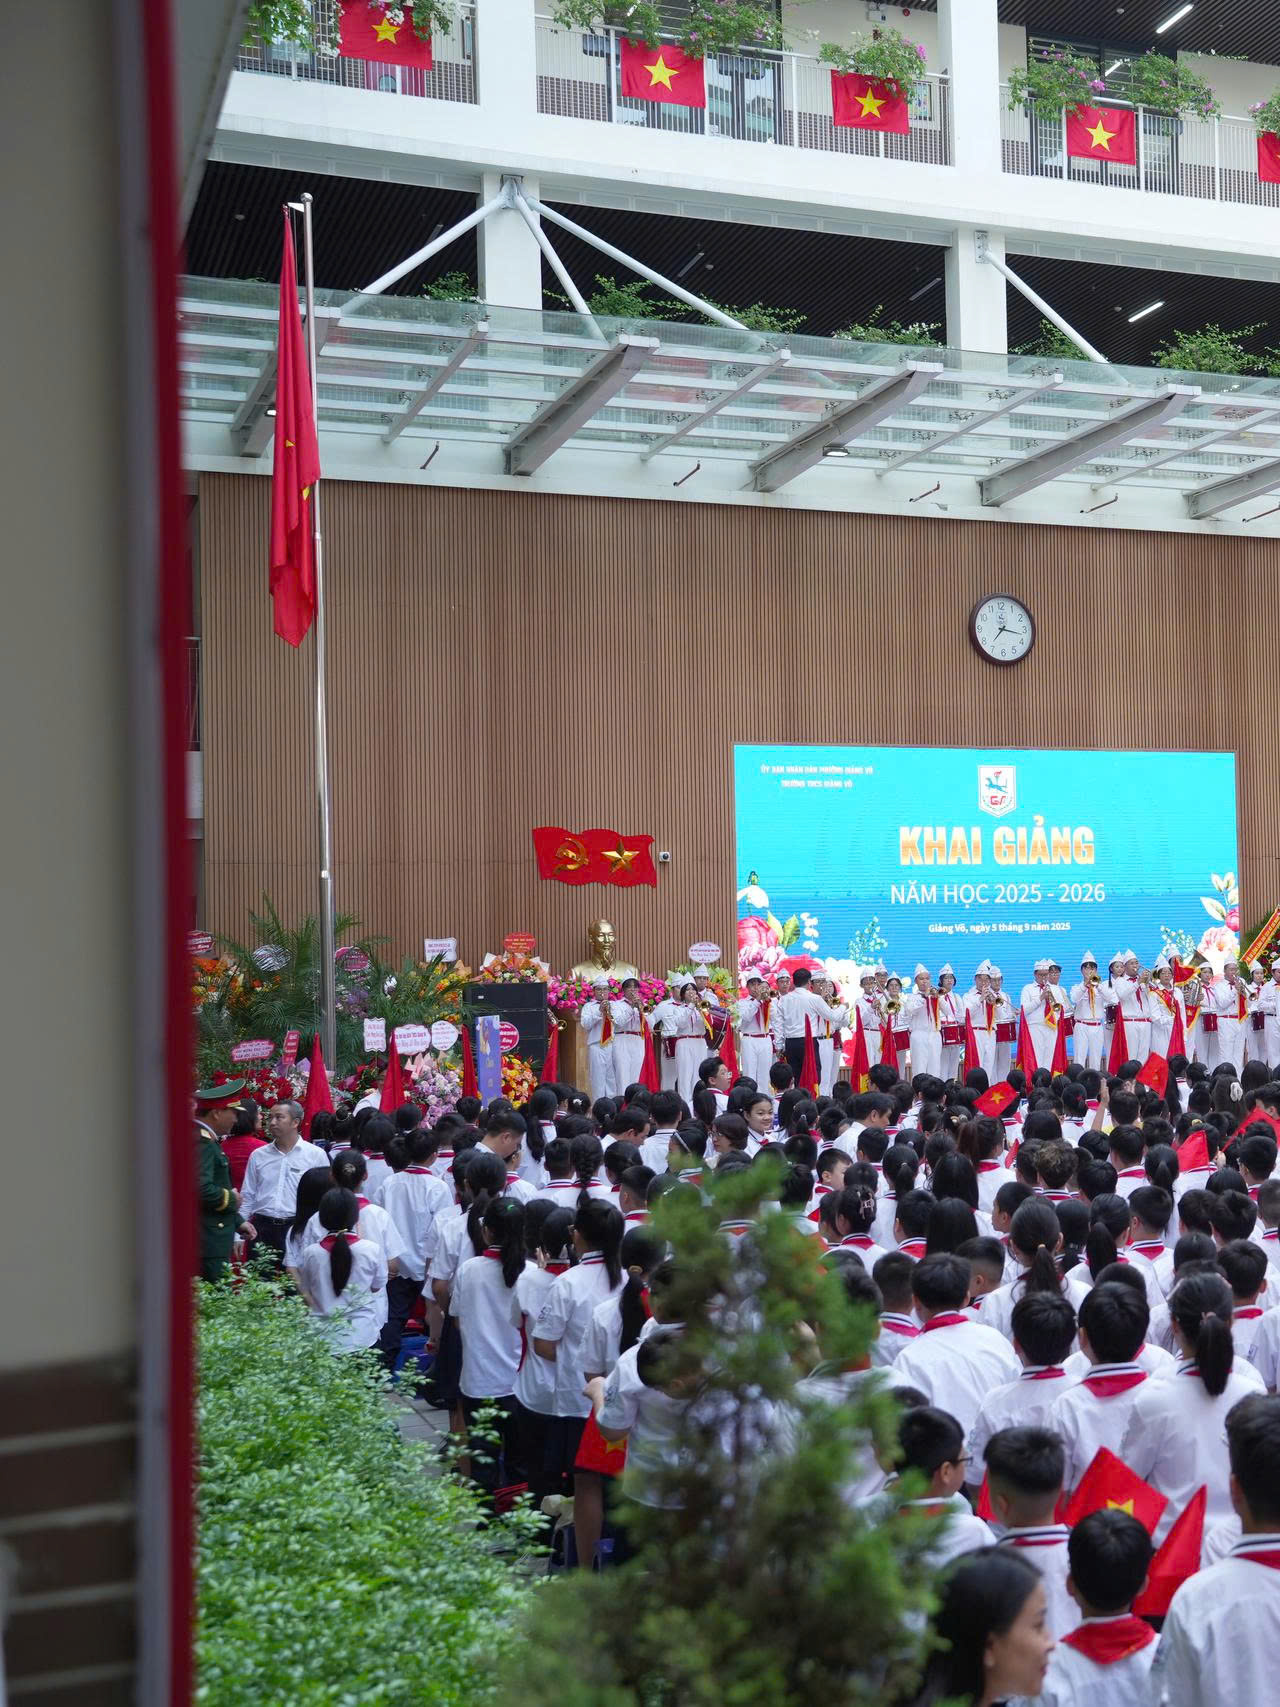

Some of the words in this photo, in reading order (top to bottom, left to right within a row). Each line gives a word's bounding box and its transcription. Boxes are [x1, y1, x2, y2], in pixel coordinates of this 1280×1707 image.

[988, 605, 994, 613] 11
[997, 602, 1005, 611] 12
[1010, 605, 1014, 613] 1
[980, 613, 988, 622] 10
[1017, 613, 1023, 623] 2
[976, 625, 983, 633] 9
[1022, 625, 1028, 634] 3
[981, 637, 987, 645] 8
[1018, 637, 1024, 646] 4
[990, 645, 995, 654] 7
[1000, 648, 1007, 657] 6
[1011, 646, 1017, 654] 5
[900, 826, 982, 865] KHAI
[993, 815, 1095, 865] GIẢNG
[891, 880, 937, 904] NĂM
[944, 883, 989, 909] HỌC
[994, 883, 1042, 904] 2025
[1059, 882, 1106, 903] 2026
[928, 922, 954, 935] Giảng
[954, 923, 968, 934] Võ,
[970, 922, 990, 934] ngày
[991, 923, 997, 932] 5
[998, 921, 1024, 933] tháng
[1024, 922, 1030, 931] 9
[1031, 921, 1050, 931] năm
[1050, 922, 1071, 931] 2025
